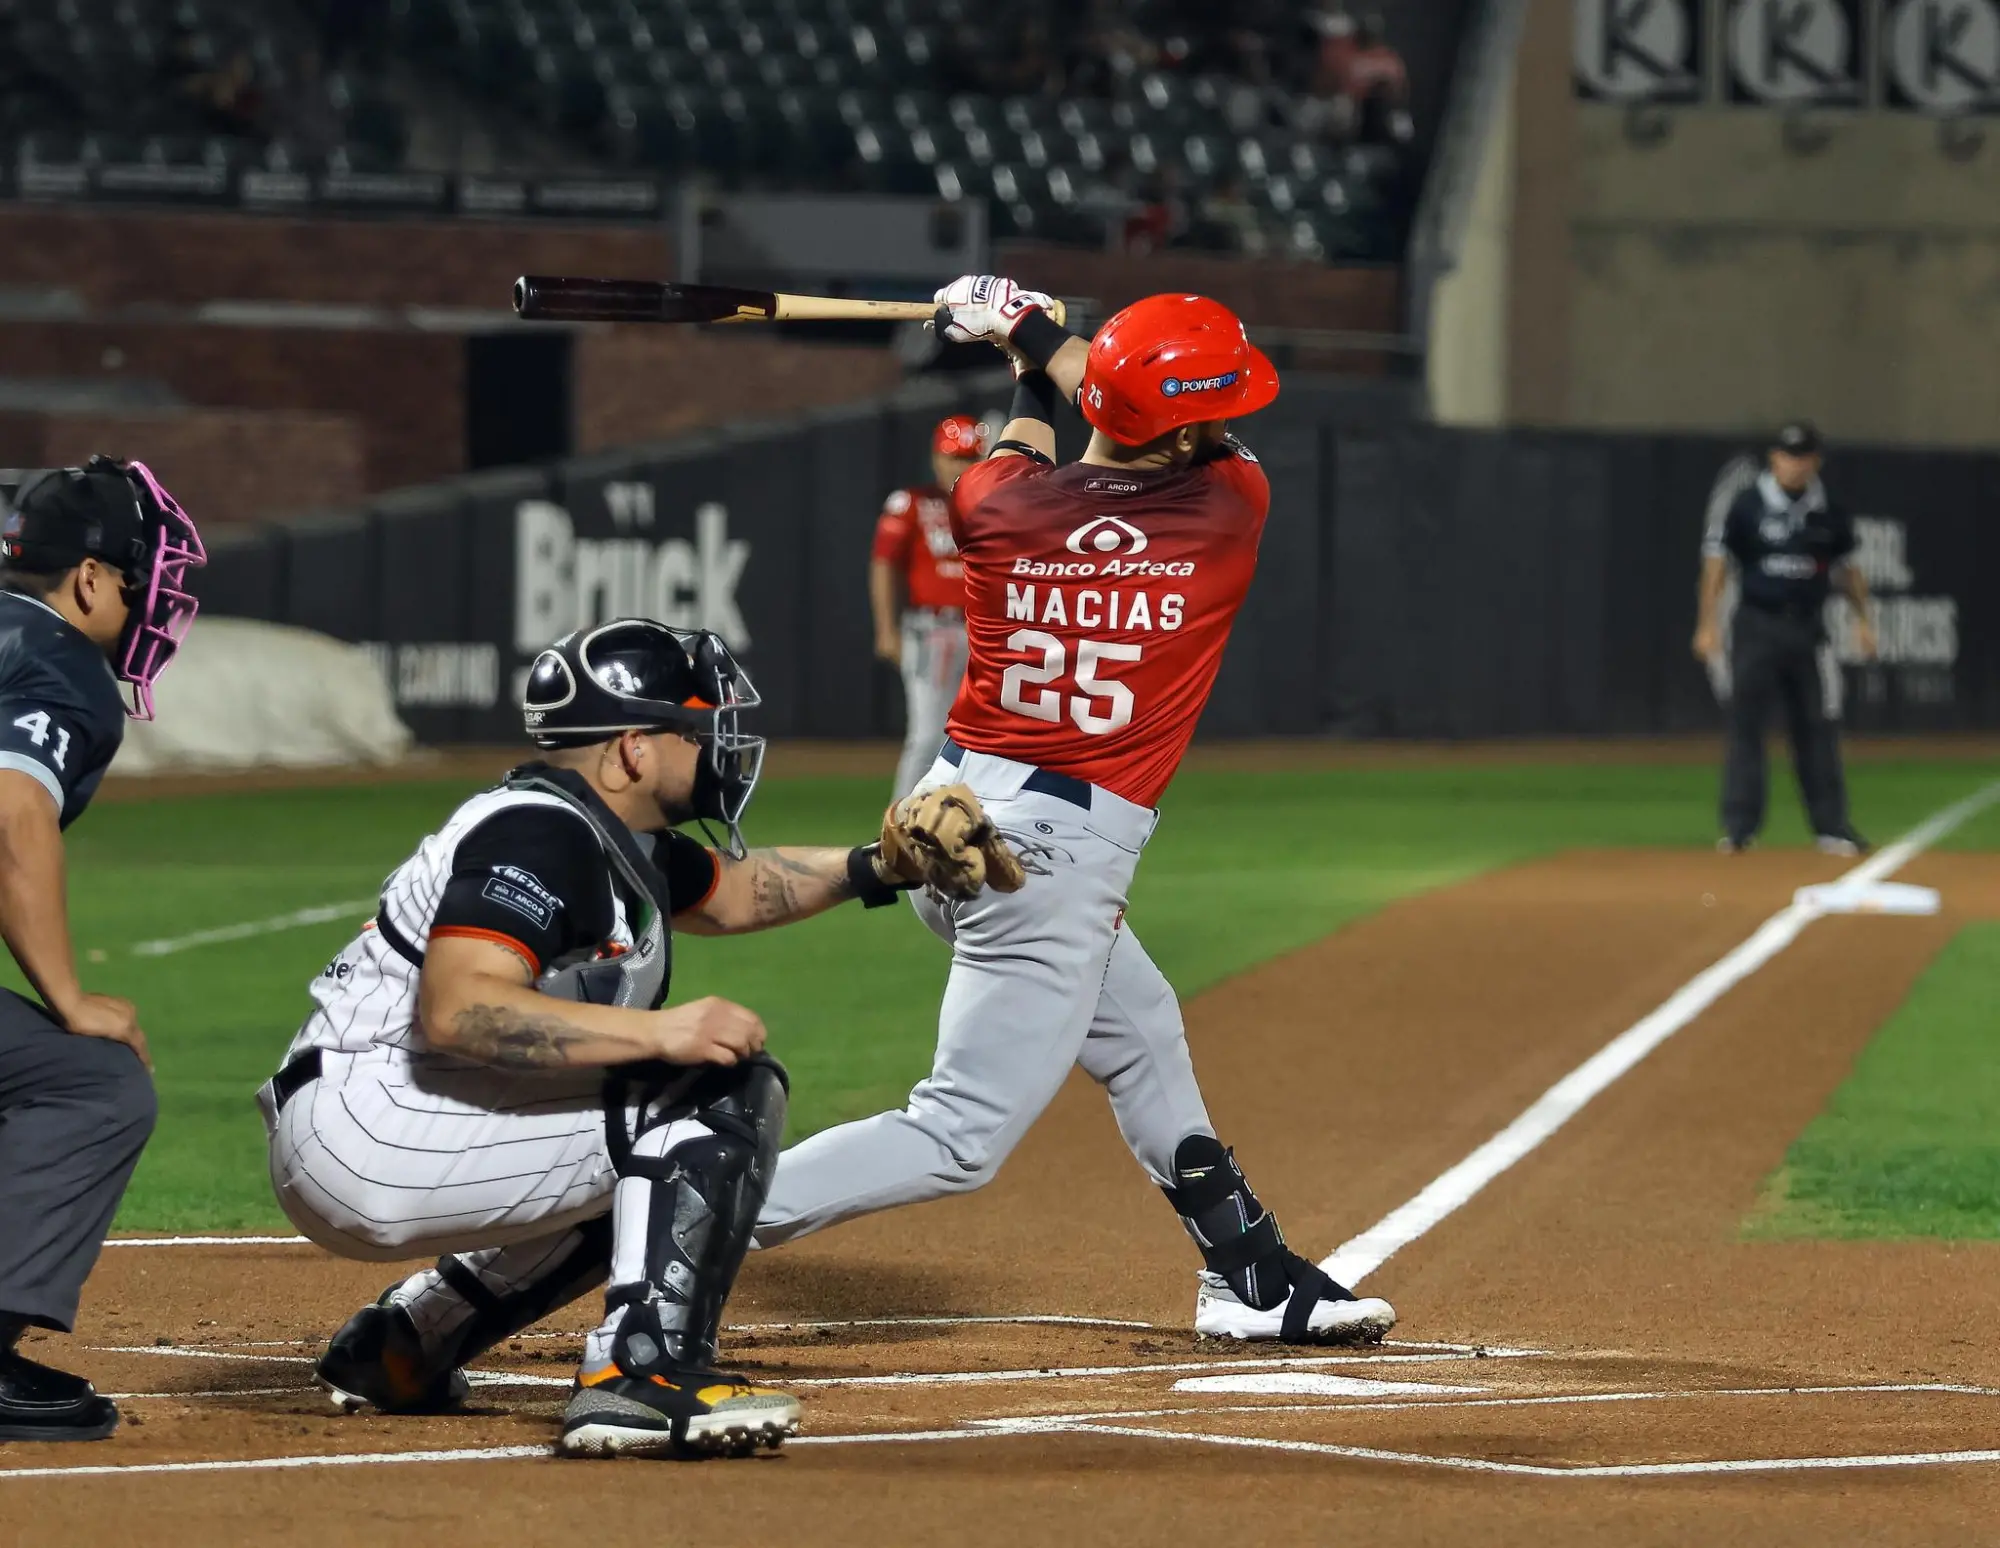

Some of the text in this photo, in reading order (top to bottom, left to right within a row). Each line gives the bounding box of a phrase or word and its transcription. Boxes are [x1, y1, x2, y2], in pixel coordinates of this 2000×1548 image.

[1088, 383, 1103, 409] 25
[1107, 483, 1130, 492] ARCO
[1011, 557, 1196, 577] Banco Azteca
[1006, 582, 1186, 631] MACIAS
[1001, 628, 1143, 735] 25
[13, 709, 71, 772] 41
[515, 894, 538, 911] ARCO
